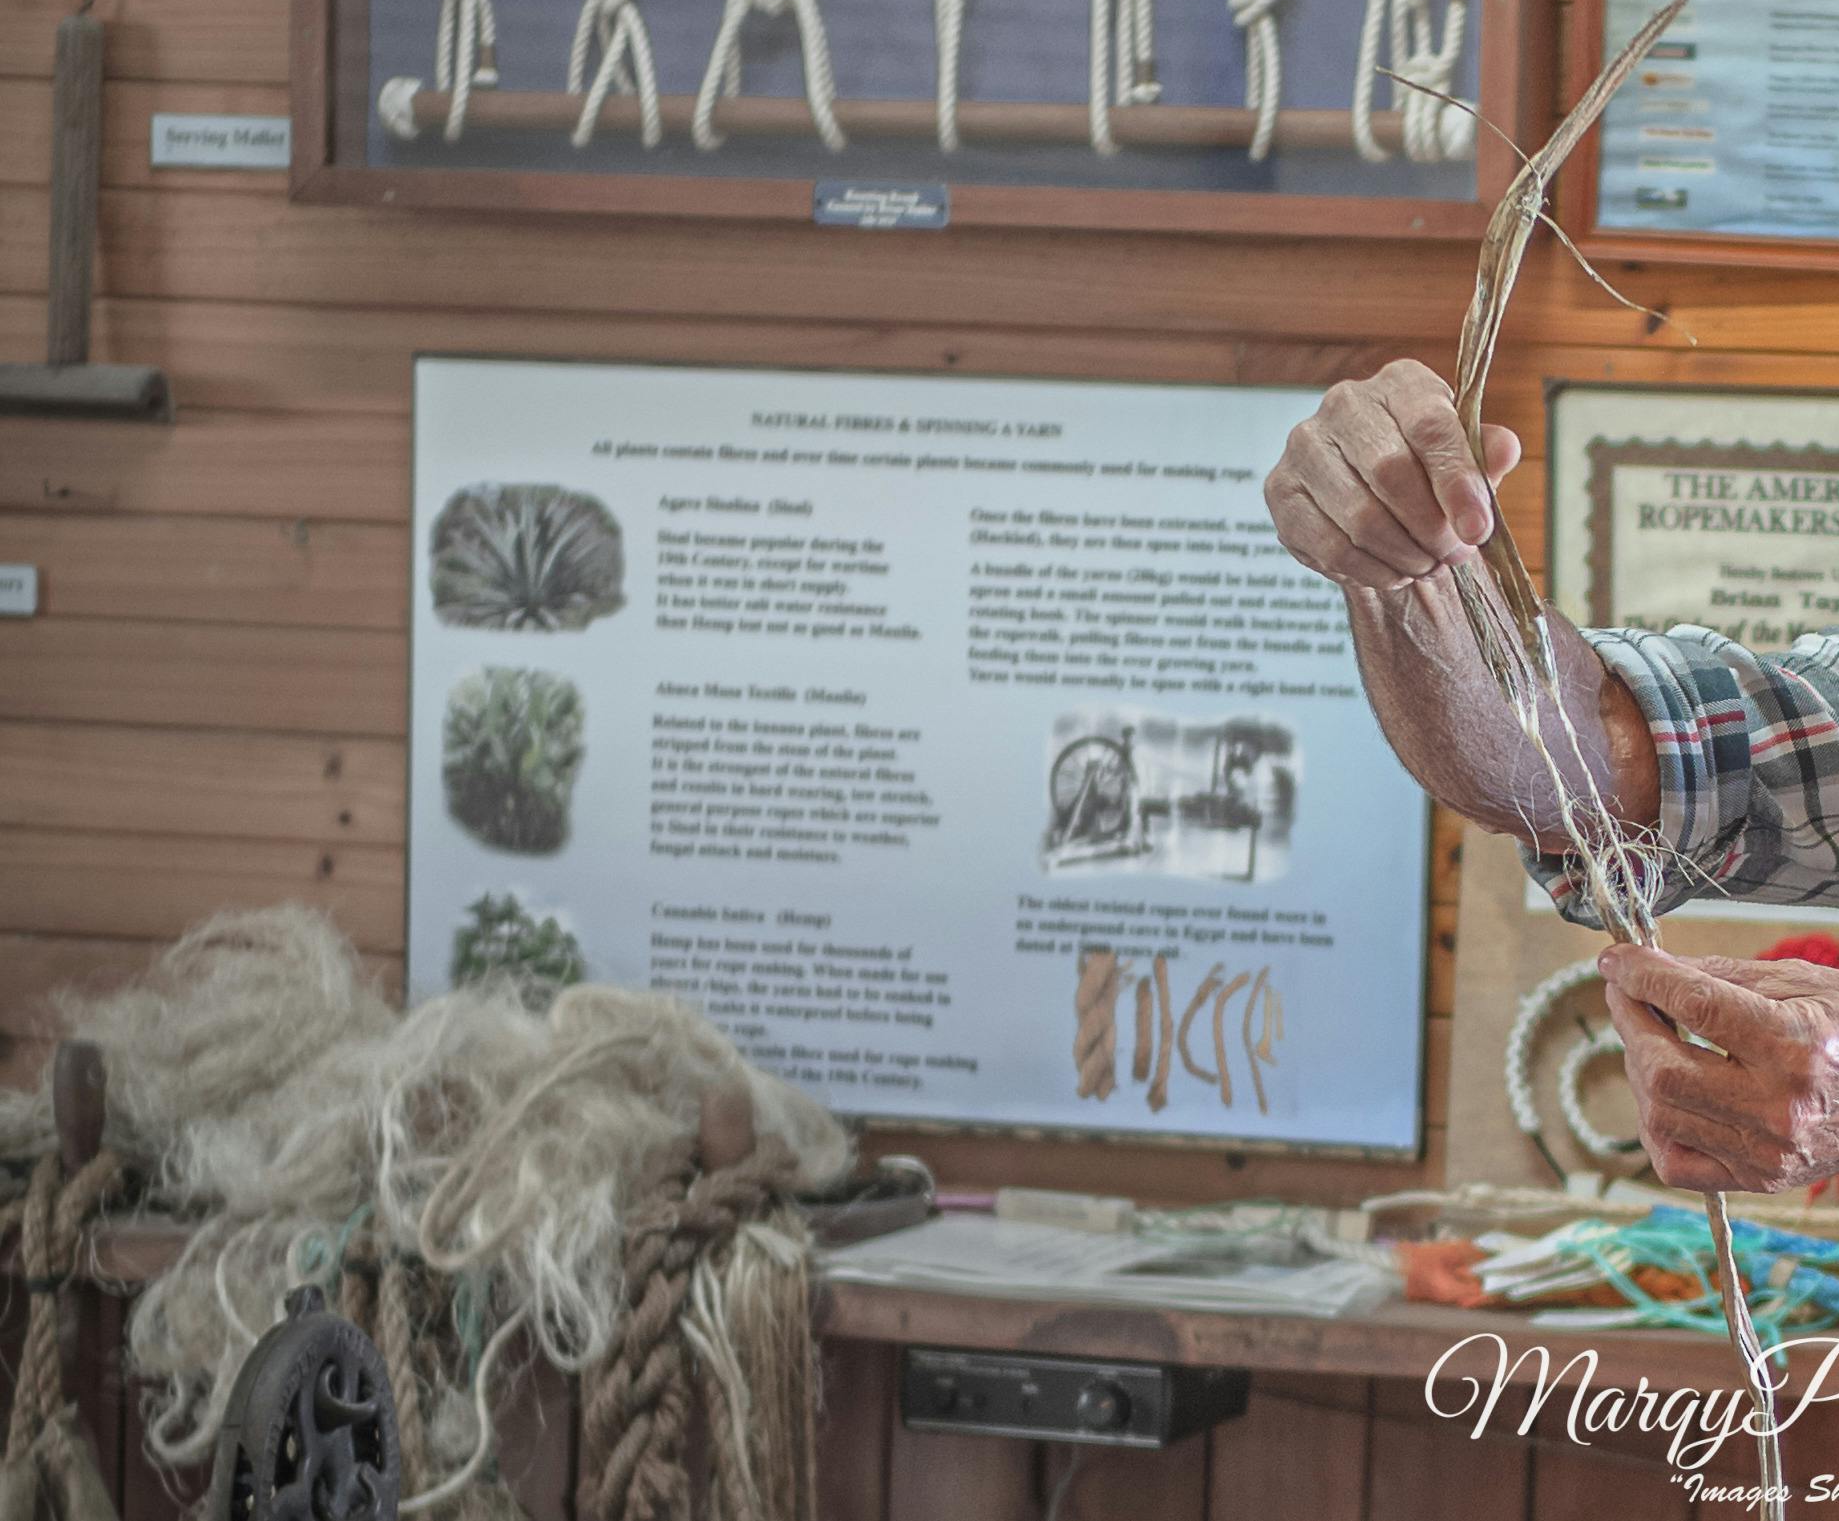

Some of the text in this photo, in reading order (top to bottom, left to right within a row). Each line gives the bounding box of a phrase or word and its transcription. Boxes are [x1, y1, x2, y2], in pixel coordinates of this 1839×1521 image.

[751, 411, 828, 429] NATURAL
[834, 415, 894, 431] FIBRES
[915, 418, 997, 436] SPINNING
[1001, 423, 1012, 437] A
[1016, 422, 1062, 438] YARN
[592, 440, 612, 455] All
[762, 447, 788, 462] and
[792, 450, 822, 464] over
[827, 450, 858, 464] time
[963, 457, 1016, 471] became
[1100, 461, 1132, 475] used
[1136, 461, 1156, 476] for
[1162, 463, 1216, 481] making
[1663, 474, 1739, 502] THE
[694, 533, 746, 547] became
[750, 535, 804, 553] popular
[810, 537, 857, 555] during
[862, 539, 883, 553] the
[1710, 587, 1781, 608] Brian
[1752, 619, 1781, 644] the
[652, 714, 705, 731] Related
[727, 718, 748, 733] the
[752, 721, 804, 736] banana
[651, 736, 710, 754] stripped
[713, 738, 748, 753] from
[752, 741, 773, 755] the
[814, 743, 828, 757] of
[832, 744, 854, 758] the
[650, 902, 718, 921] Cannabis
[775, 909, 832, 929] (Hemp)
